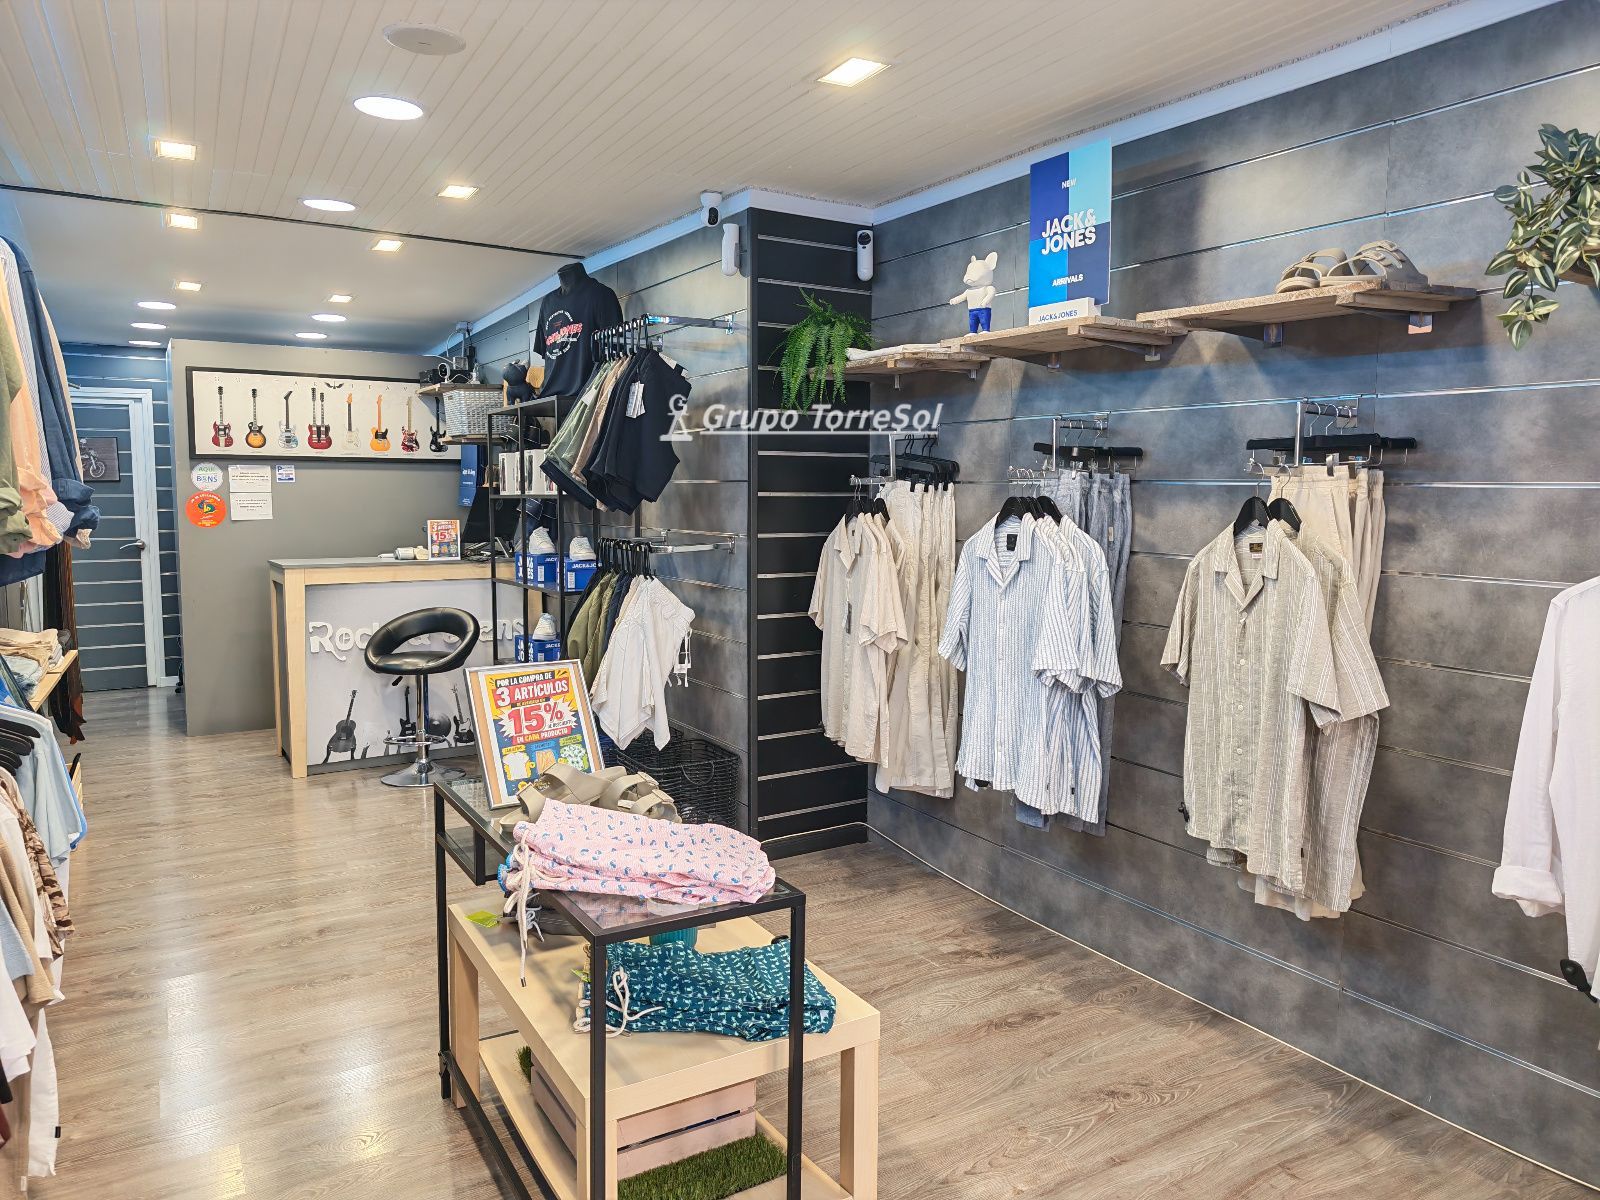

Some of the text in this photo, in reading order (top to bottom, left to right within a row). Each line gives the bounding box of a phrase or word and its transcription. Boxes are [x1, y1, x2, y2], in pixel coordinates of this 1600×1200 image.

[1061, 178, 1077, 189] NEW
[1041, 208, 1096, 238] JACK&
[1041, 226, 1096, 256] JONES
[1052, 274, 1084, 288] ARRIVALS
[496, 679, 509, 687] POR
[518, 673, 544, 684] COMPRA
[544, 672, 553, 680] DE
[496, 686, 511, 707] 3
[514, 680, 569, 701] ARTÍCULOS
[507, 702, 564, 735] 15%
[516, 736, 524, 744] EN
[540, 728, 568, 739] PRODUCTO
